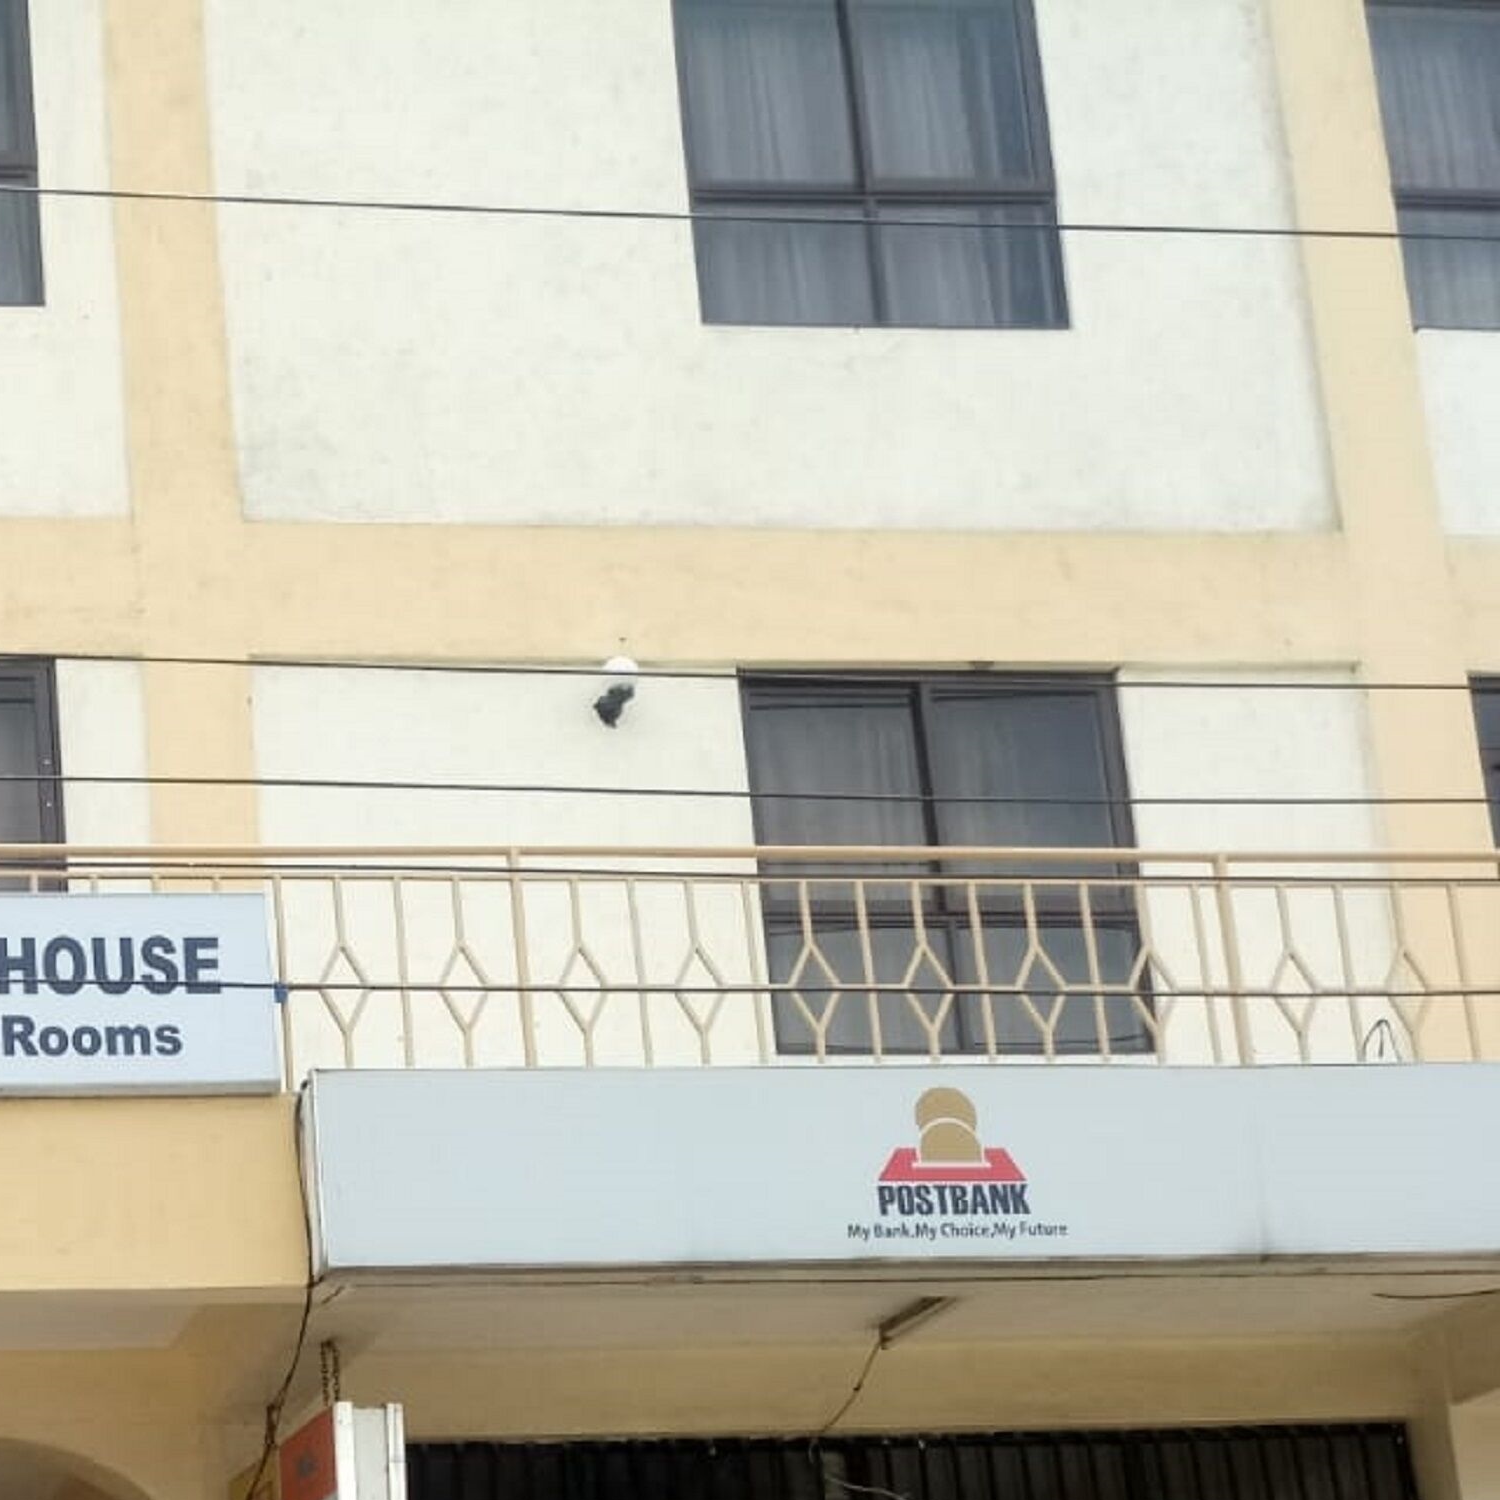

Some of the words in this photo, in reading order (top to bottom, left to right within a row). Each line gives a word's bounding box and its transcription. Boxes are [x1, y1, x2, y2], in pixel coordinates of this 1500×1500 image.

[2, 1014, 184, 1058] Rooms
[878, 1184, 1031, 1216] POSTBANK
[848, 1224, 869, 1241] My
[1020, 1221, 1068, 1236] Future
